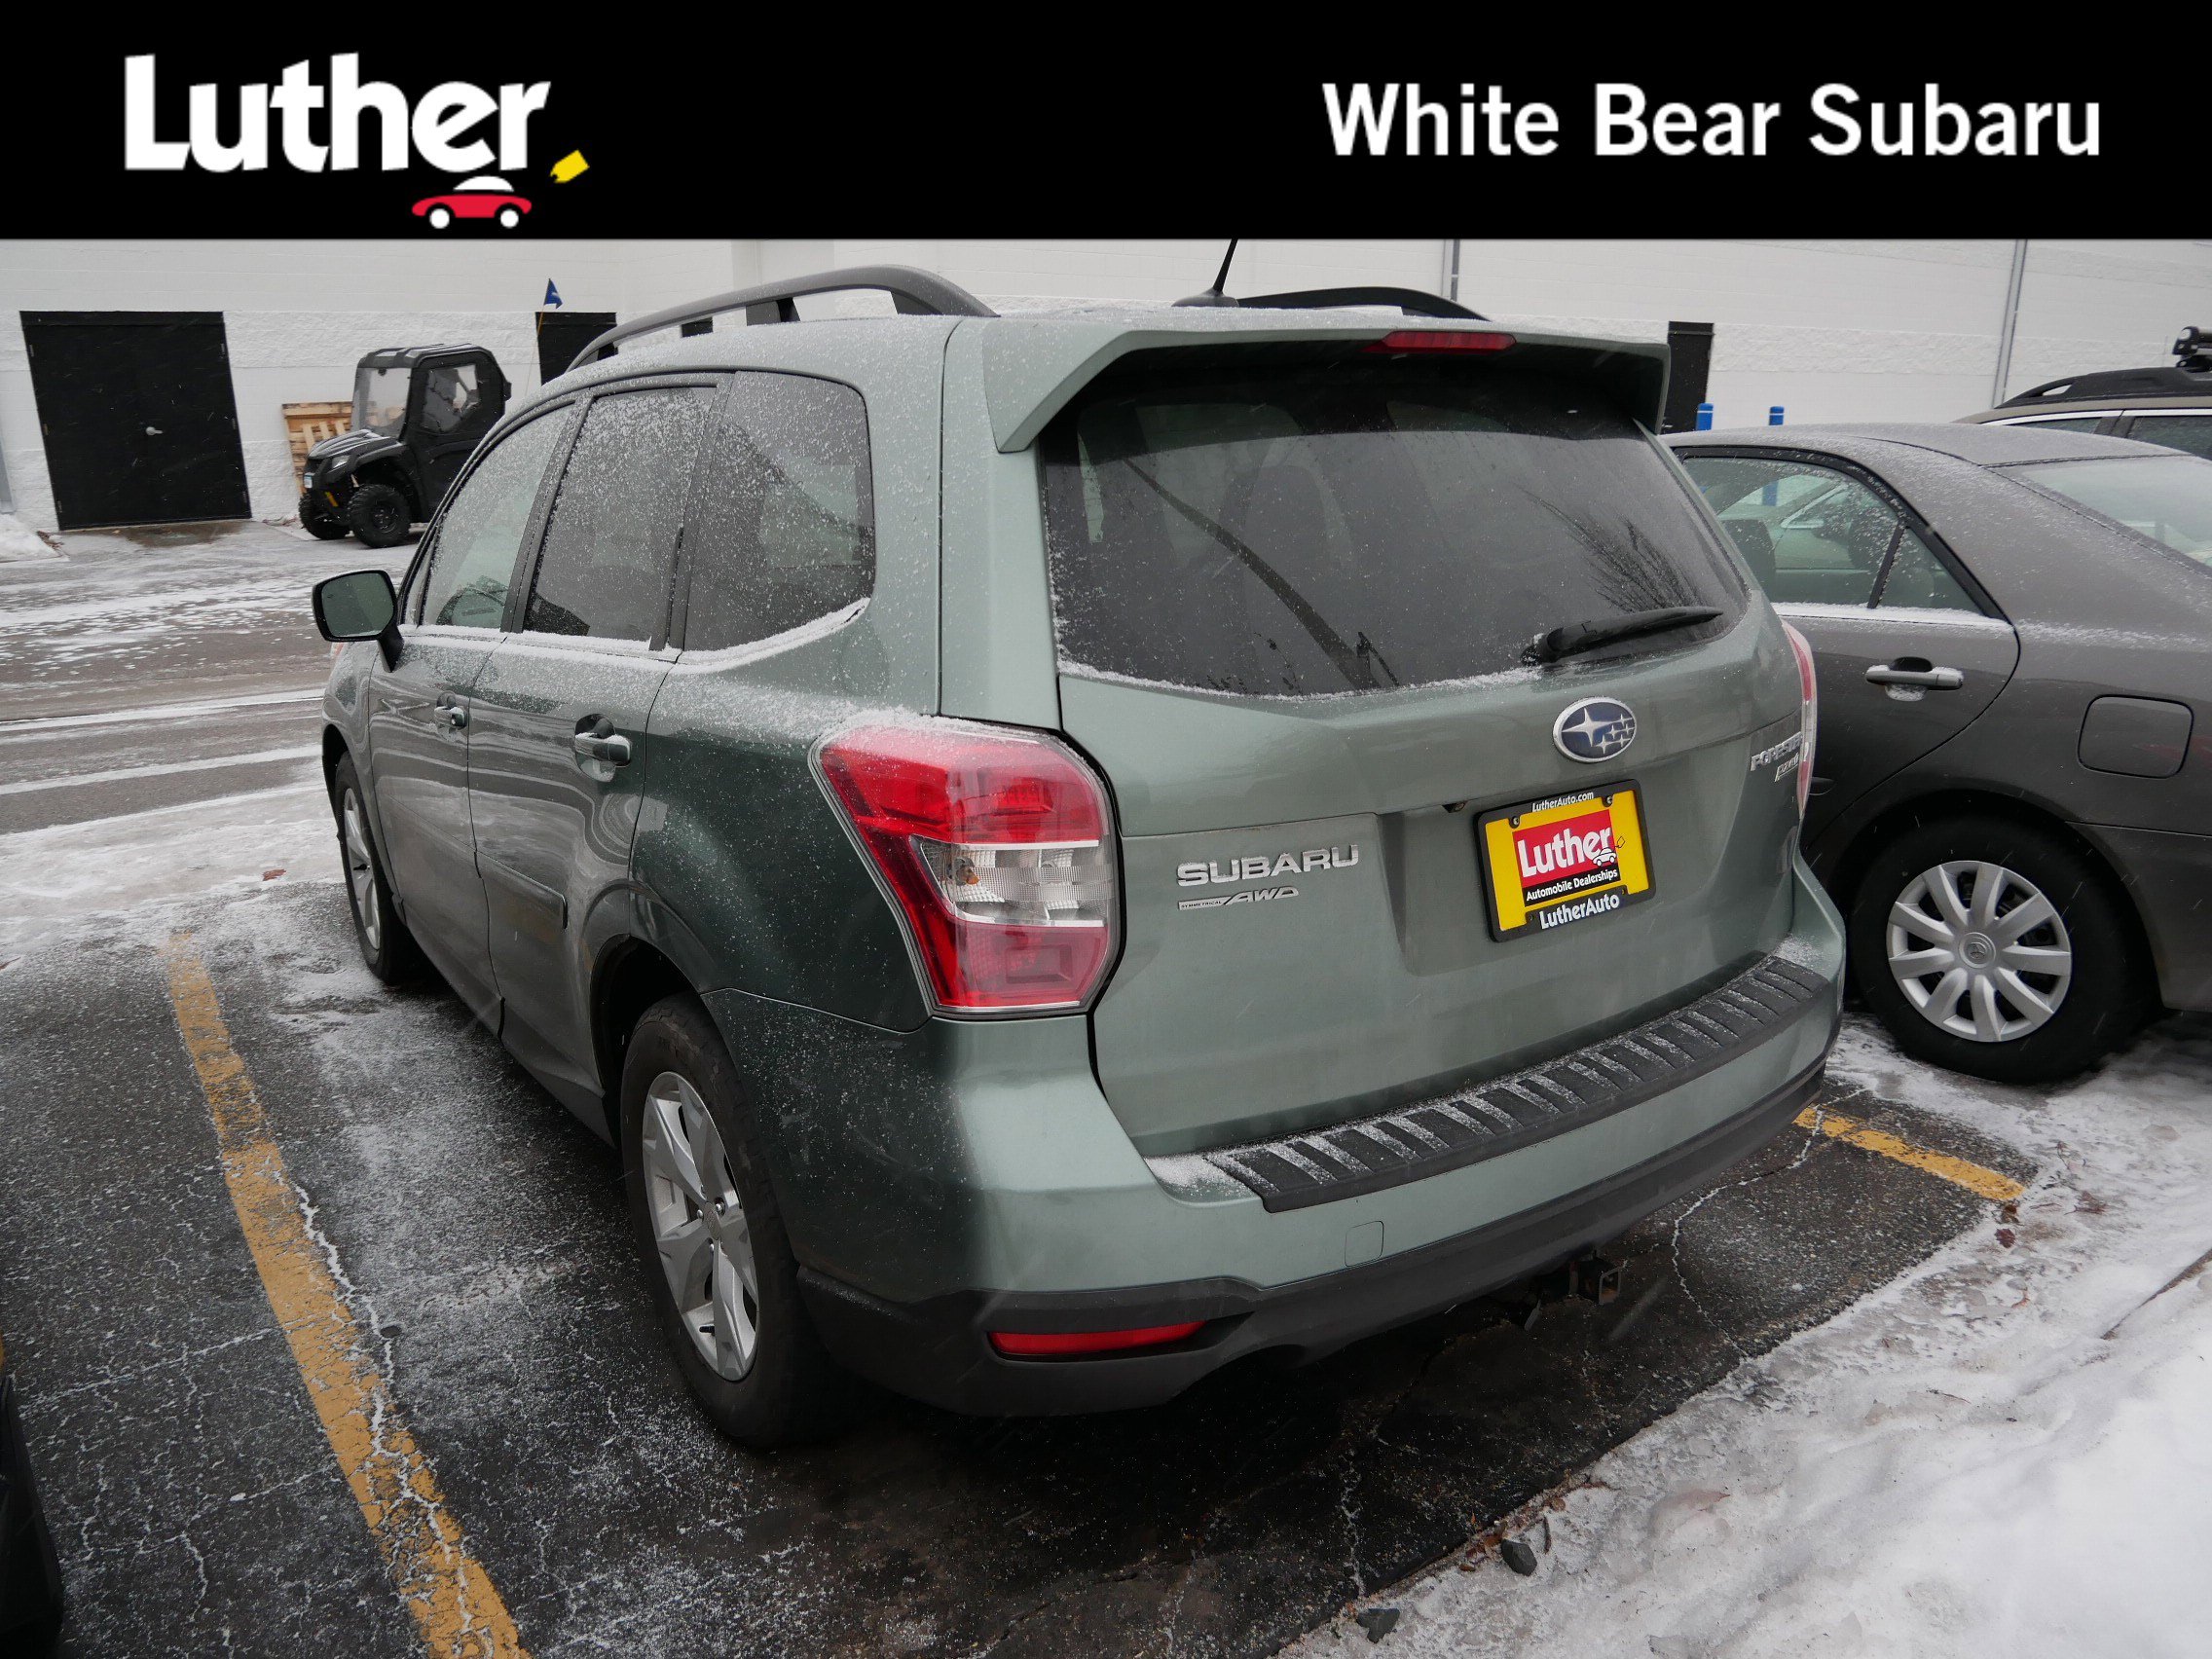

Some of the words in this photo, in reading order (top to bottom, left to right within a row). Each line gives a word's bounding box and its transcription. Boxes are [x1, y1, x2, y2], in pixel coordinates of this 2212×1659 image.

[1531, 792, 1594, 813] LutherAuto.com
[1177, 844, 1359, 887] SUBARU
[1517, 827, 1612, 878] Luther
[1224, 886, 1300, 905] AWD
[1526, 880, 1572, 902] Automobile
[1573, 868, 1618, 888] Dealerships
[1538, 894, 1620, 930] LutherAuto
